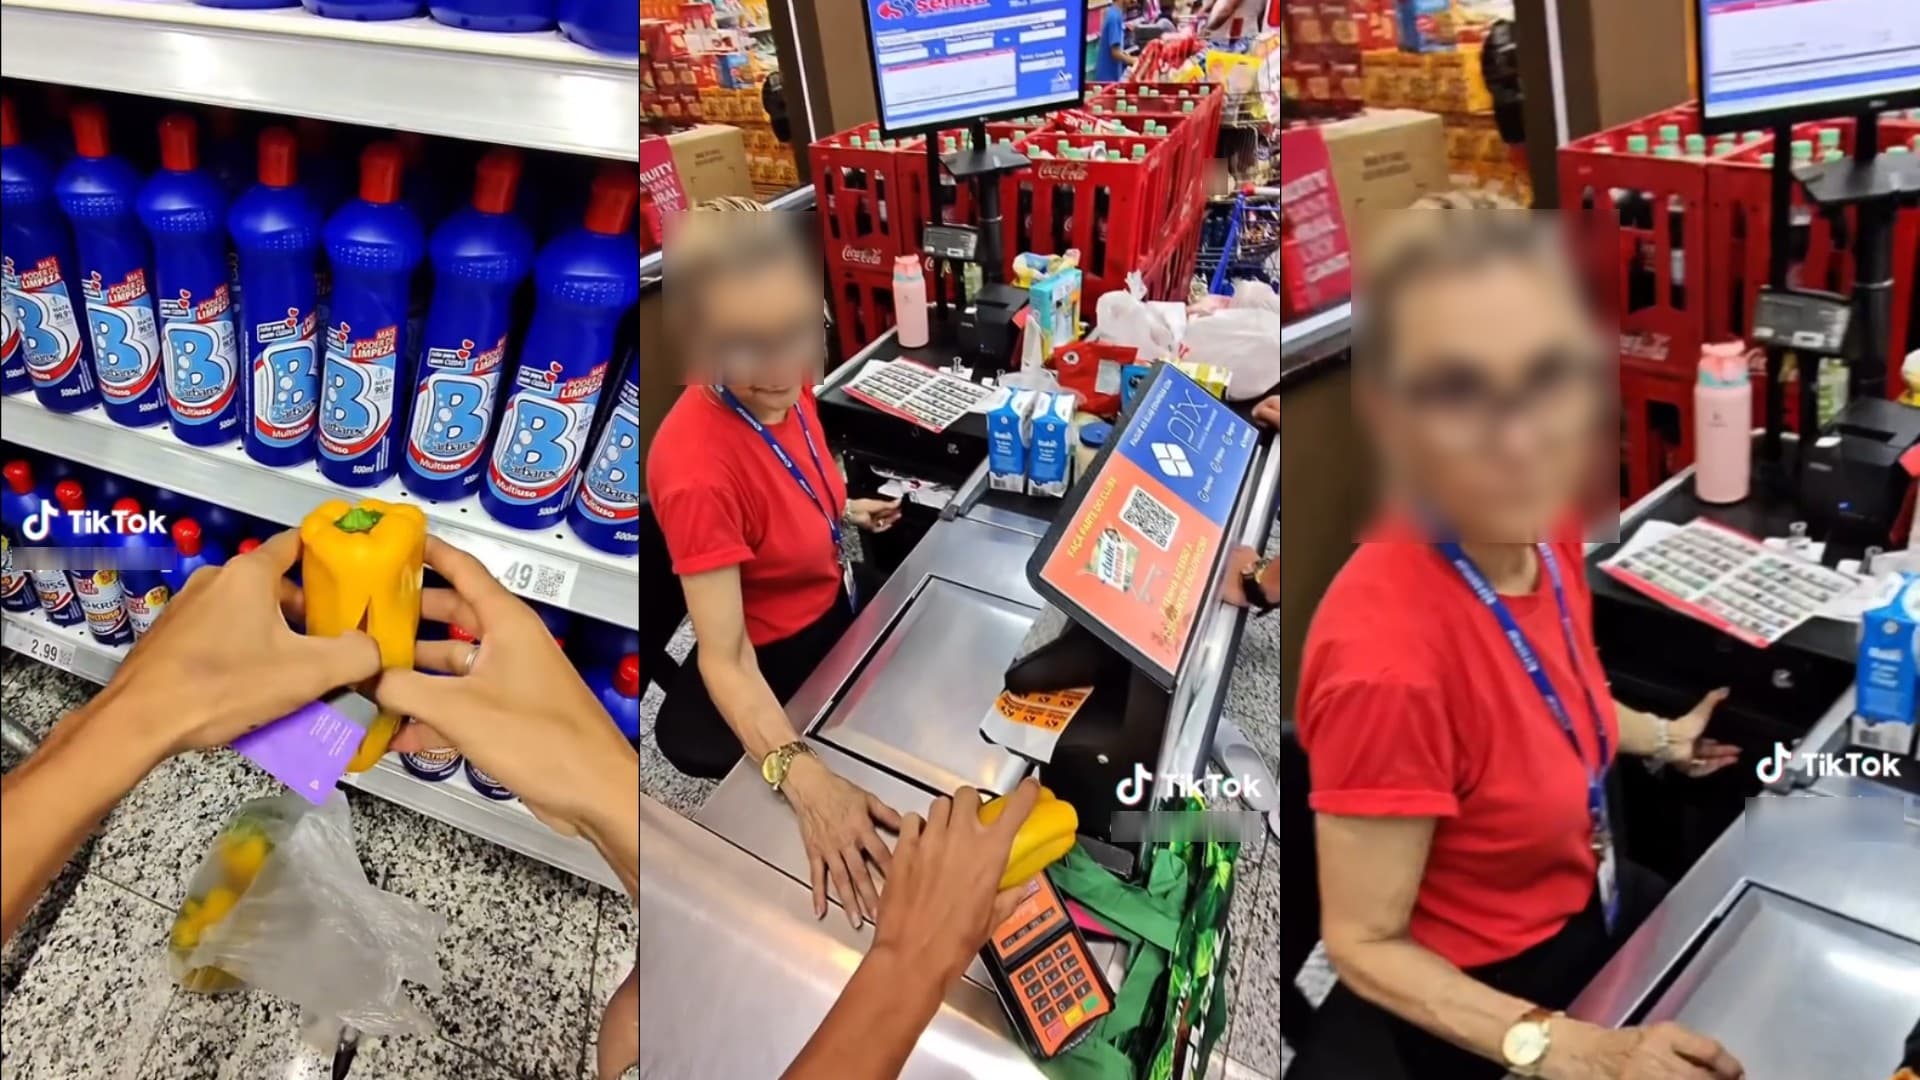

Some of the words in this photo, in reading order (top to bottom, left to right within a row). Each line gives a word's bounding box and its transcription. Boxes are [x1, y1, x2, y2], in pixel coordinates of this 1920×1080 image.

[21, 272, 60, 289] LIMPEZA
[108, 284, 147, 304] LIMPEZA
[352, 343, 395, 359] LIMPEZA
[1158, 387, 1209, 455] pix
[352, 463, 375, 475] 500ml
[420, 457, 461, 471] Multiuso
[496, 477, 537, 498] Multiuso
[613, 530, 639, 542] 500m
[1102, 542, 1115, 579] clube
[31, 638, 58, 662] 2.99
